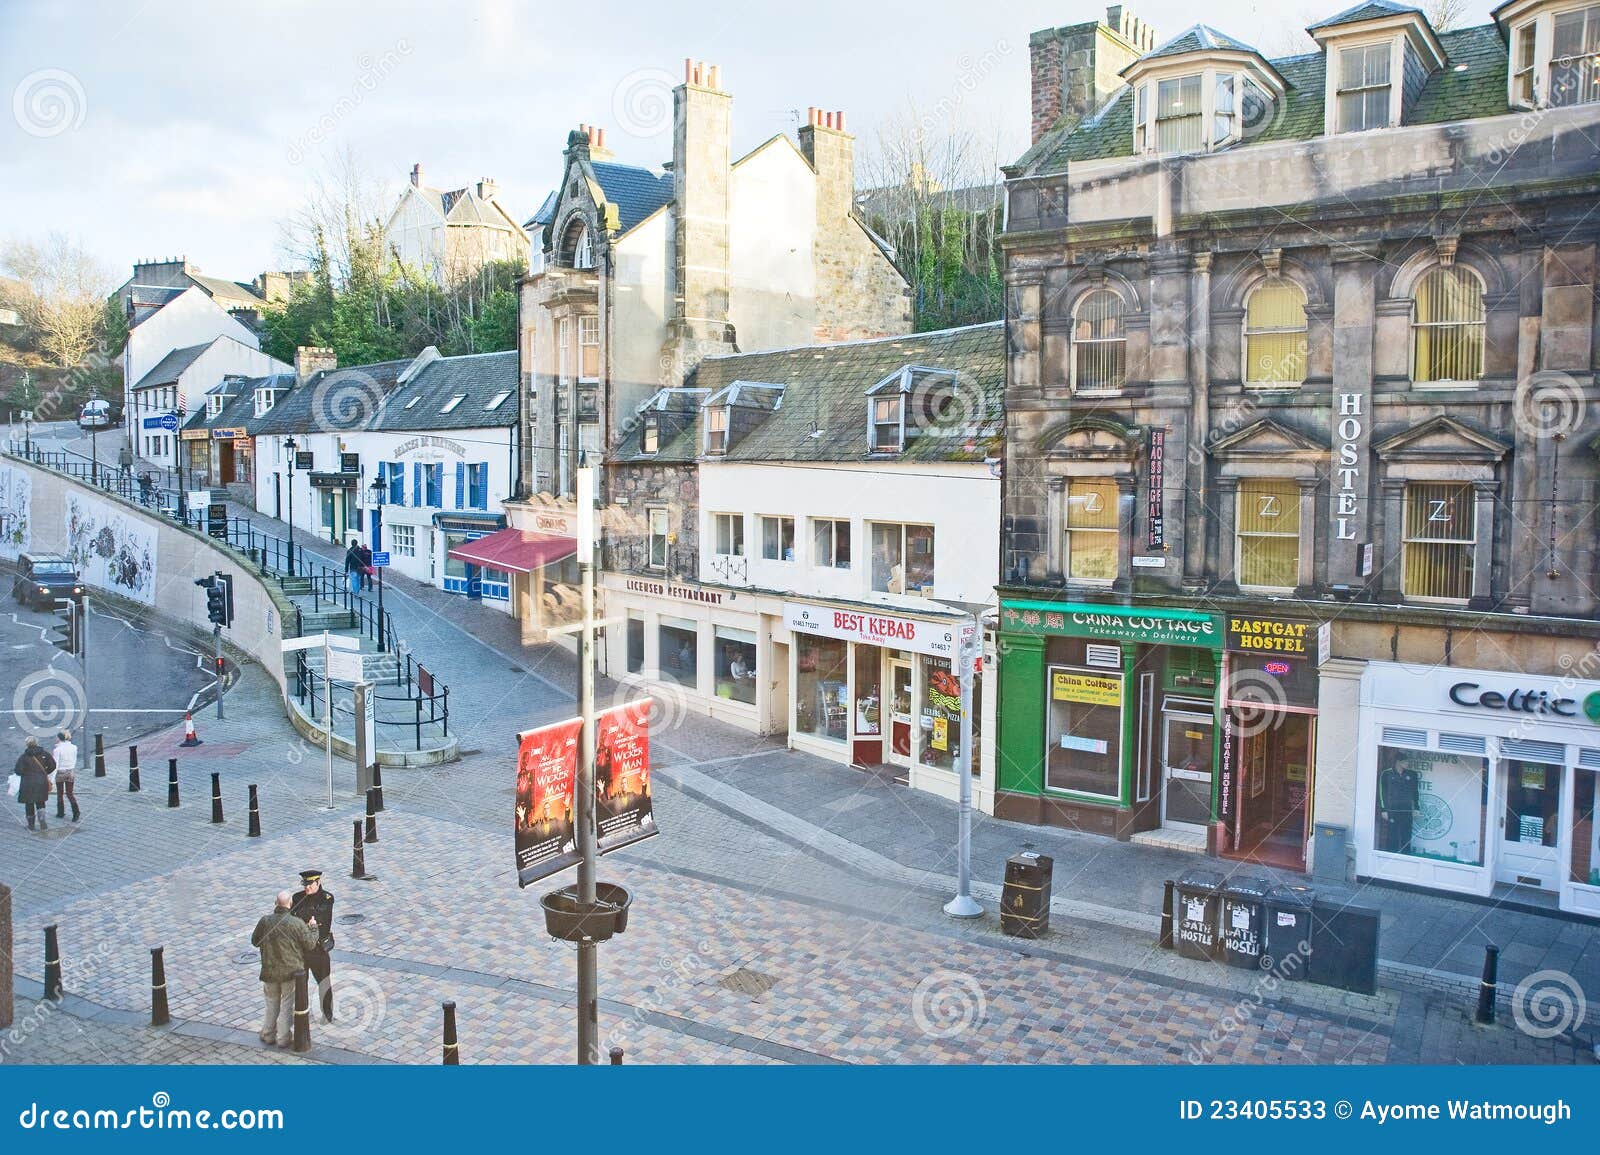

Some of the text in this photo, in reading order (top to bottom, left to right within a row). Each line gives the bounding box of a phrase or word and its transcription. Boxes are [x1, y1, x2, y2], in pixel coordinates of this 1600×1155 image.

[1336, 392, 1363, 540] HOSTEL
[626, 580, 722, 604] LICENSED RESTAURANT
[833, 611, 915, 641] BEST KEBAB
[1072, 612, 1214, 634] CHINA COTTAGE
[1088, 626, 1136, 637] Takeaway
[1153, 632, 1198, 642] Delivery
[1240, 635, 1305, 652] HOSTEL
[1267, 663, 1288, 673] OPEN
[1057, 676, 1118, 691] China Cottage
[1449, 682, 1576, 716] Celtic
